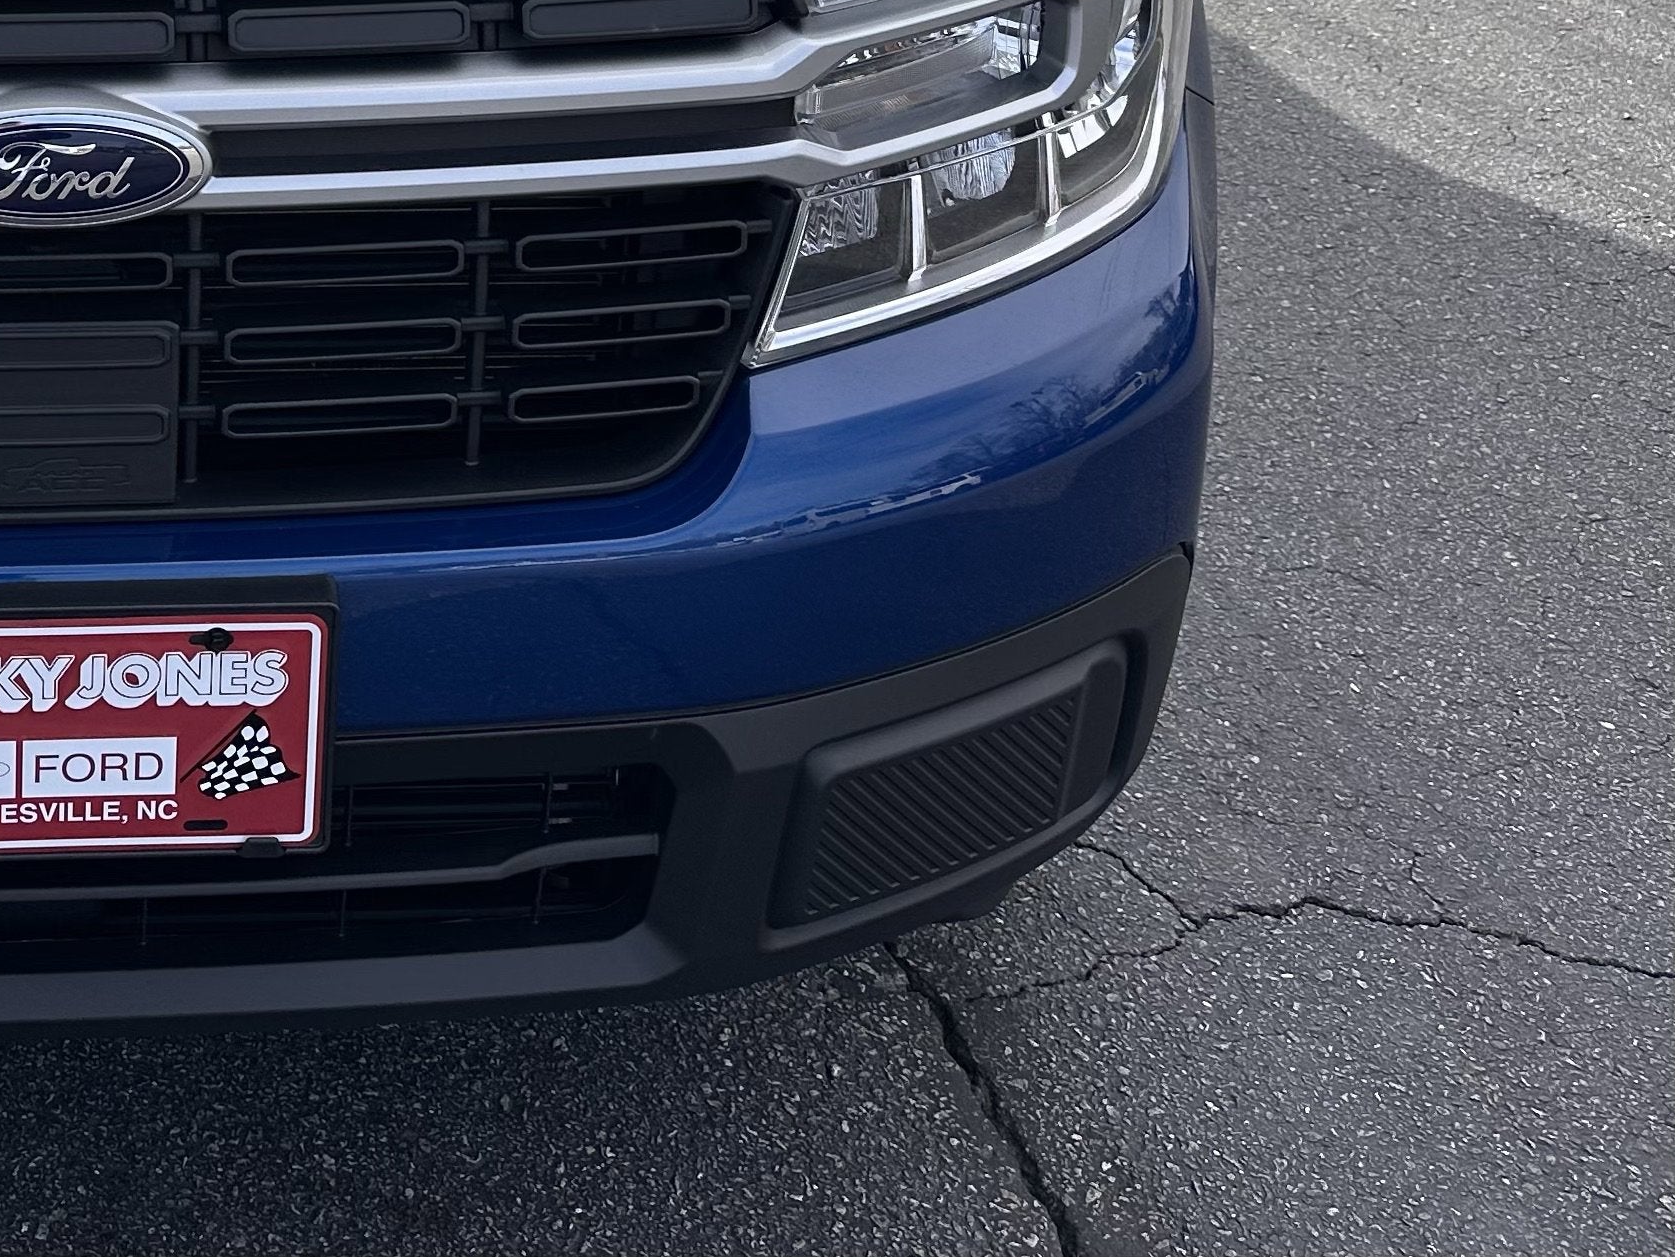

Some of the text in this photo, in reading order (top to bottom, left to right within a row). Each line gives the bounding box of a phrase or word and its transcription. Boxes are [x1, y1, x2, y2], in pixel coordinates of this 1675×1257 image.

[65, 648, 290, 710] JONES
[33, 752, 165, 784] FORD
[137, 800, 179, 821] NC
